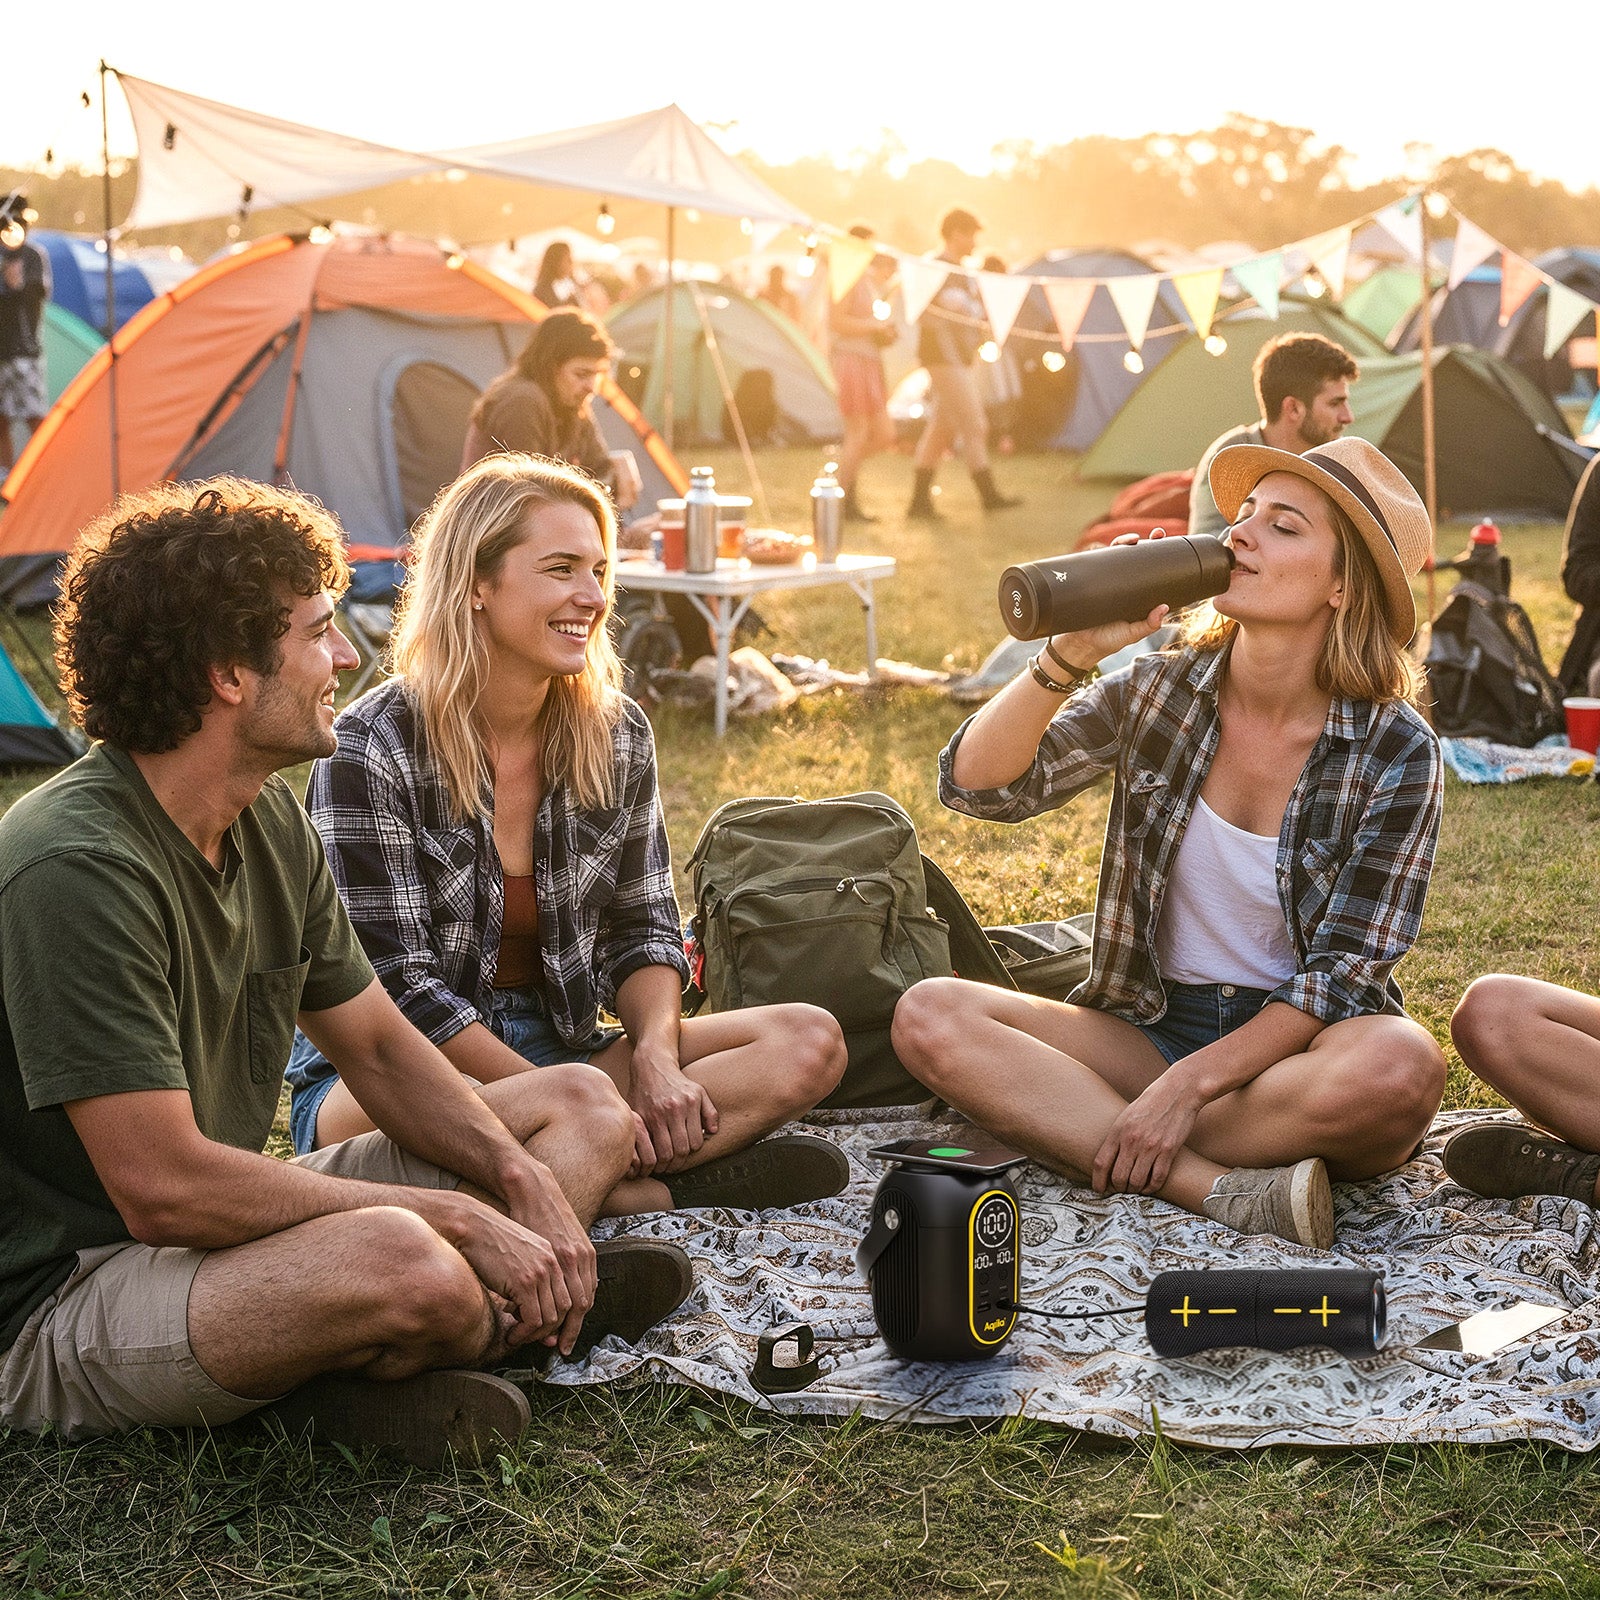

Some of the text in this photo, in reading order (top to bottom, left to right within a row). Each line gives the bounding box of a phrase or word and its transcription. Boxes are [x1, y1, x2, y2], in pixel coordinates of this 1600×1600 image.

[983, 1212, 1007, 1235] 100
[974, 1255, 989, 1270] 100
[997, 1250, 1011, 1264] 100
